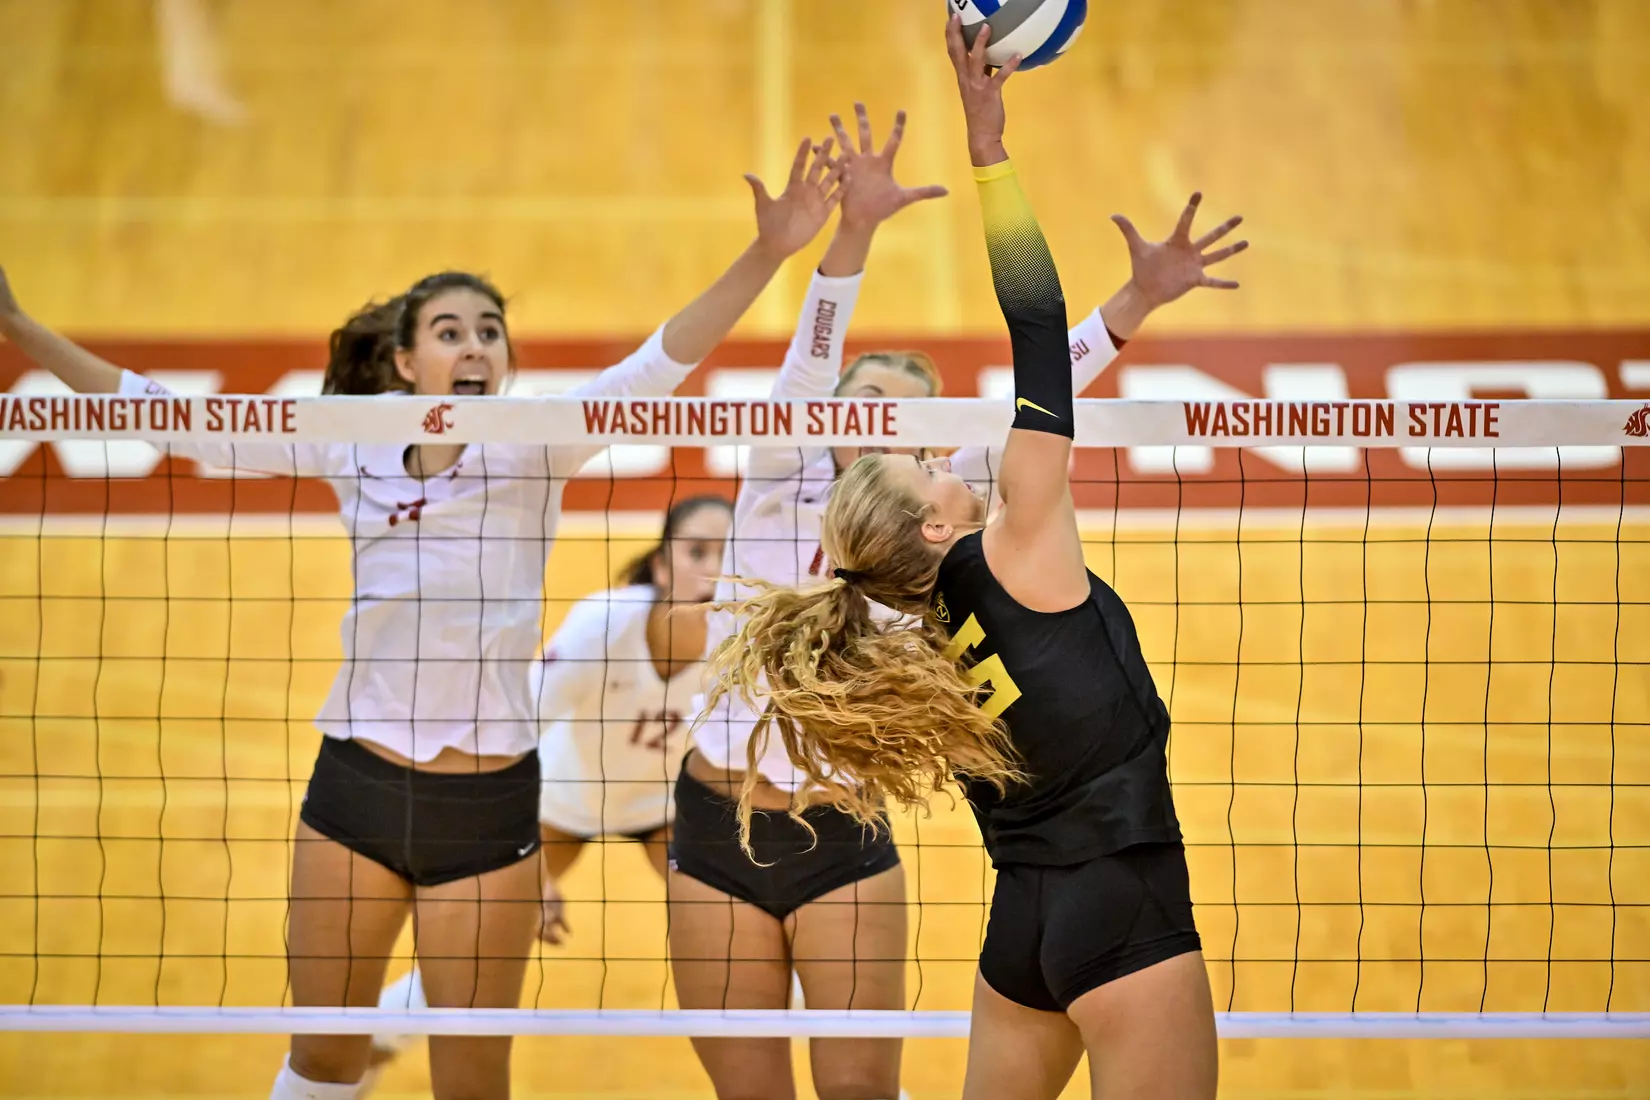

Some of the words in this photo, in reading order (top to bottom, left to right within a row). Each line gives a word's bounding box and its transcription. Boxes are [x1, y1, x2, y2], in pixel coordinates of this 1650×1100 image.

[811, 298, 838, 360] COUGARS
[1068, 338, 1090, 366] SU
[206, 401, 297, 433] STATE
[582, 401, 792, 436] WASHINGTON
[806, 402, 898, 437] STATE
[1184, 402, 1395, 437] WASHINGTON
[1407, 403, 1500, 438] STATE
[628, 708, 681, 752] 12
